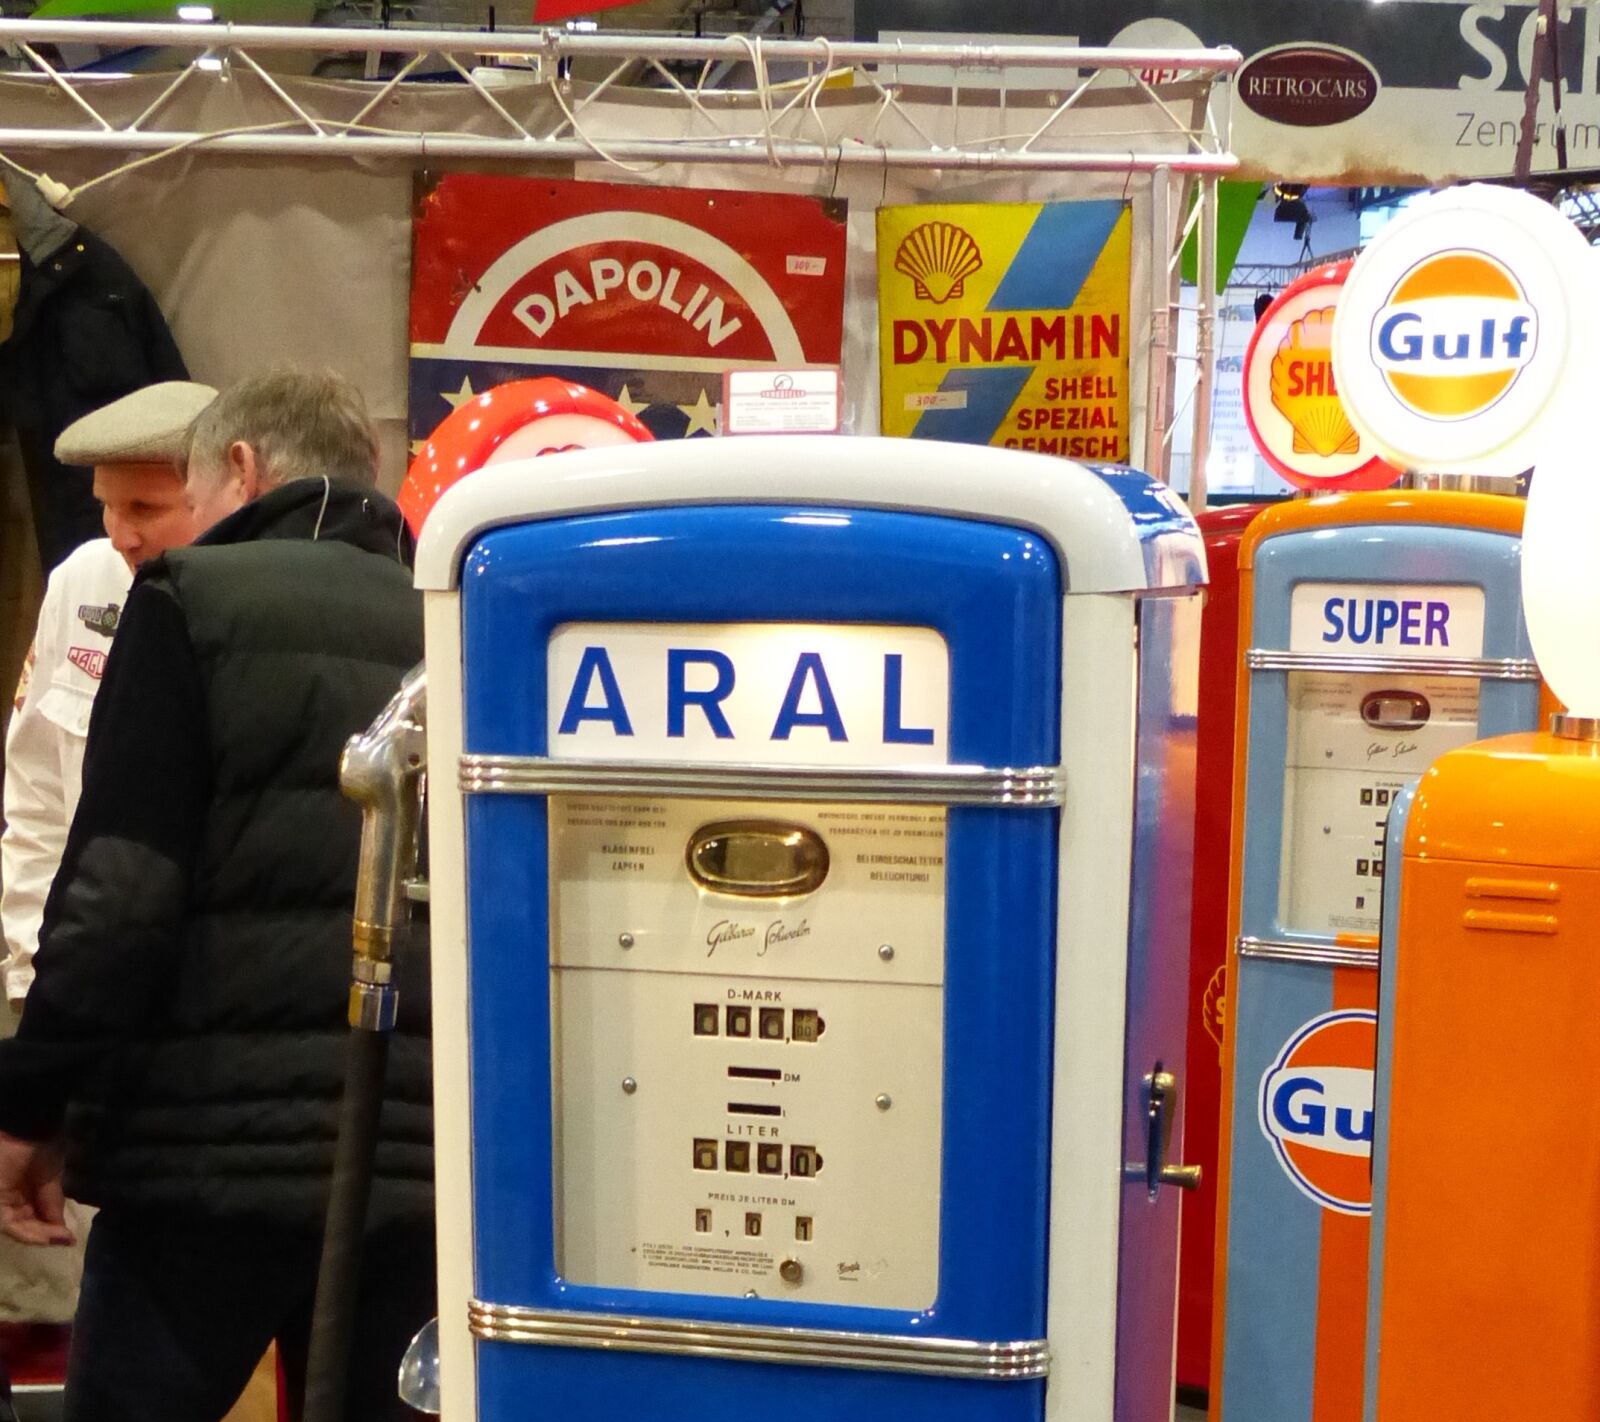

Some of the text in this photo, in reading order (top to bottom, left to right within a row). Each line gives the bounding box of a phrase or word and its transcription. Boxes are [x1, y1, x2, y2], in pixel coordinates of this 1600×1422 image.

[1458, 4, 1600, 94] SC
[1249, 76, 1367, 98] RETROCARS
[1455, 112, 1600, 149] Zenrum
[513, 258, 742, 348] DAPOLIN
[893, 314, 1120, 364] DYNAMIN
[1378, 312, 1530, 361] Gulf
[1045, 376, 1118, 400] SHELL
[1287, 361, 1338, 397] SHE
[1017, 406, 1118, 430] SPEZIAL
[1322, 597, 1450, 647] SUPER
[71, 650, 106, 677] JAGU
[558, 646, 935, 746] ARAL
[727, 988, 782, 1001] D-MARK
[784, 1073, 800, 1082] DM
[1272, 1077, 1375, 1141] Gu
[727, 1123, 779, 1137] LITER
[708, 1192, 735, 1201] PREIS
[738, 1194, 749, 1203] JE
[752, 1196, 778, 1205] LITER
